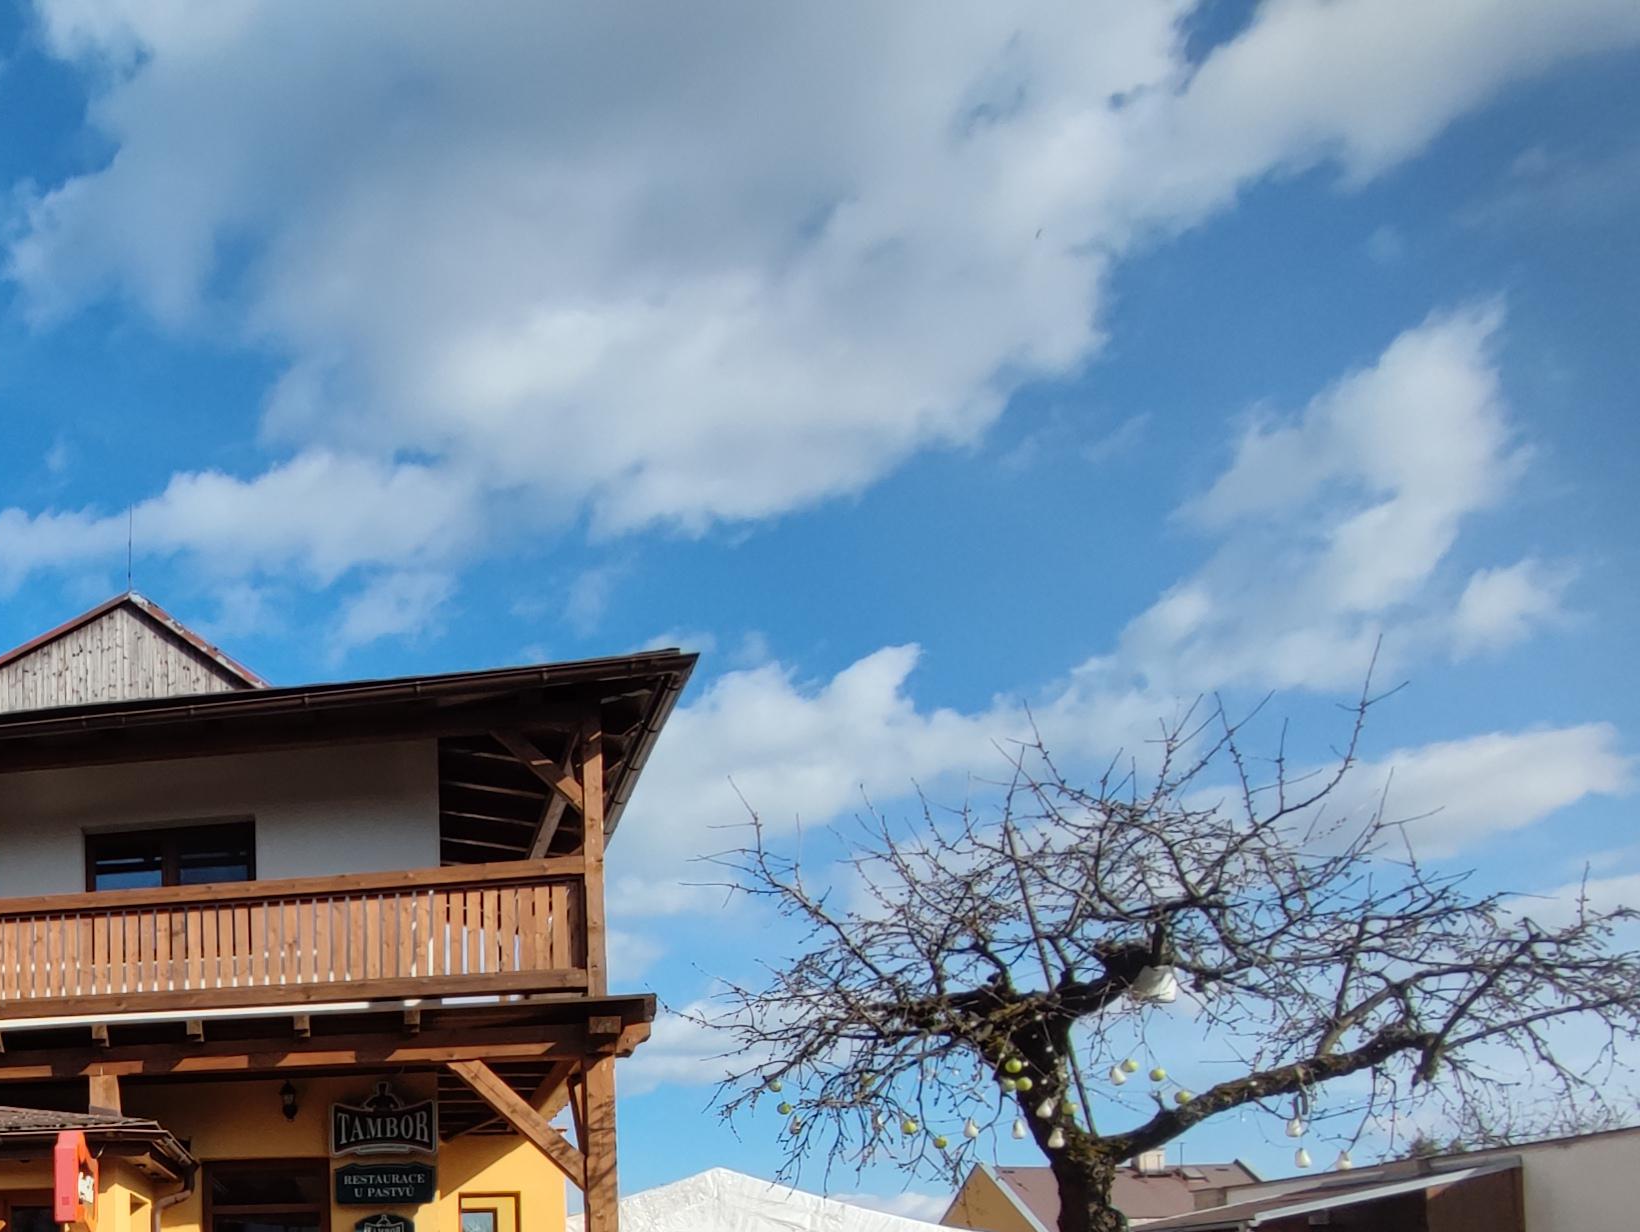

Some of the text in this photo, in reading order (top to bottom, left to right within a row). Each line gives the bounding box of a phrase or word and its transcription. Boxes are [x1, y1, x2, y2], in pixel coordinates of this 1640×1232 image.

[337, 1111, 430, 1145] TAMBOR
[343, 1174, 425, 1185] RESTAURACE
[354, 1185, 415, 1198] U PASTVŮ
